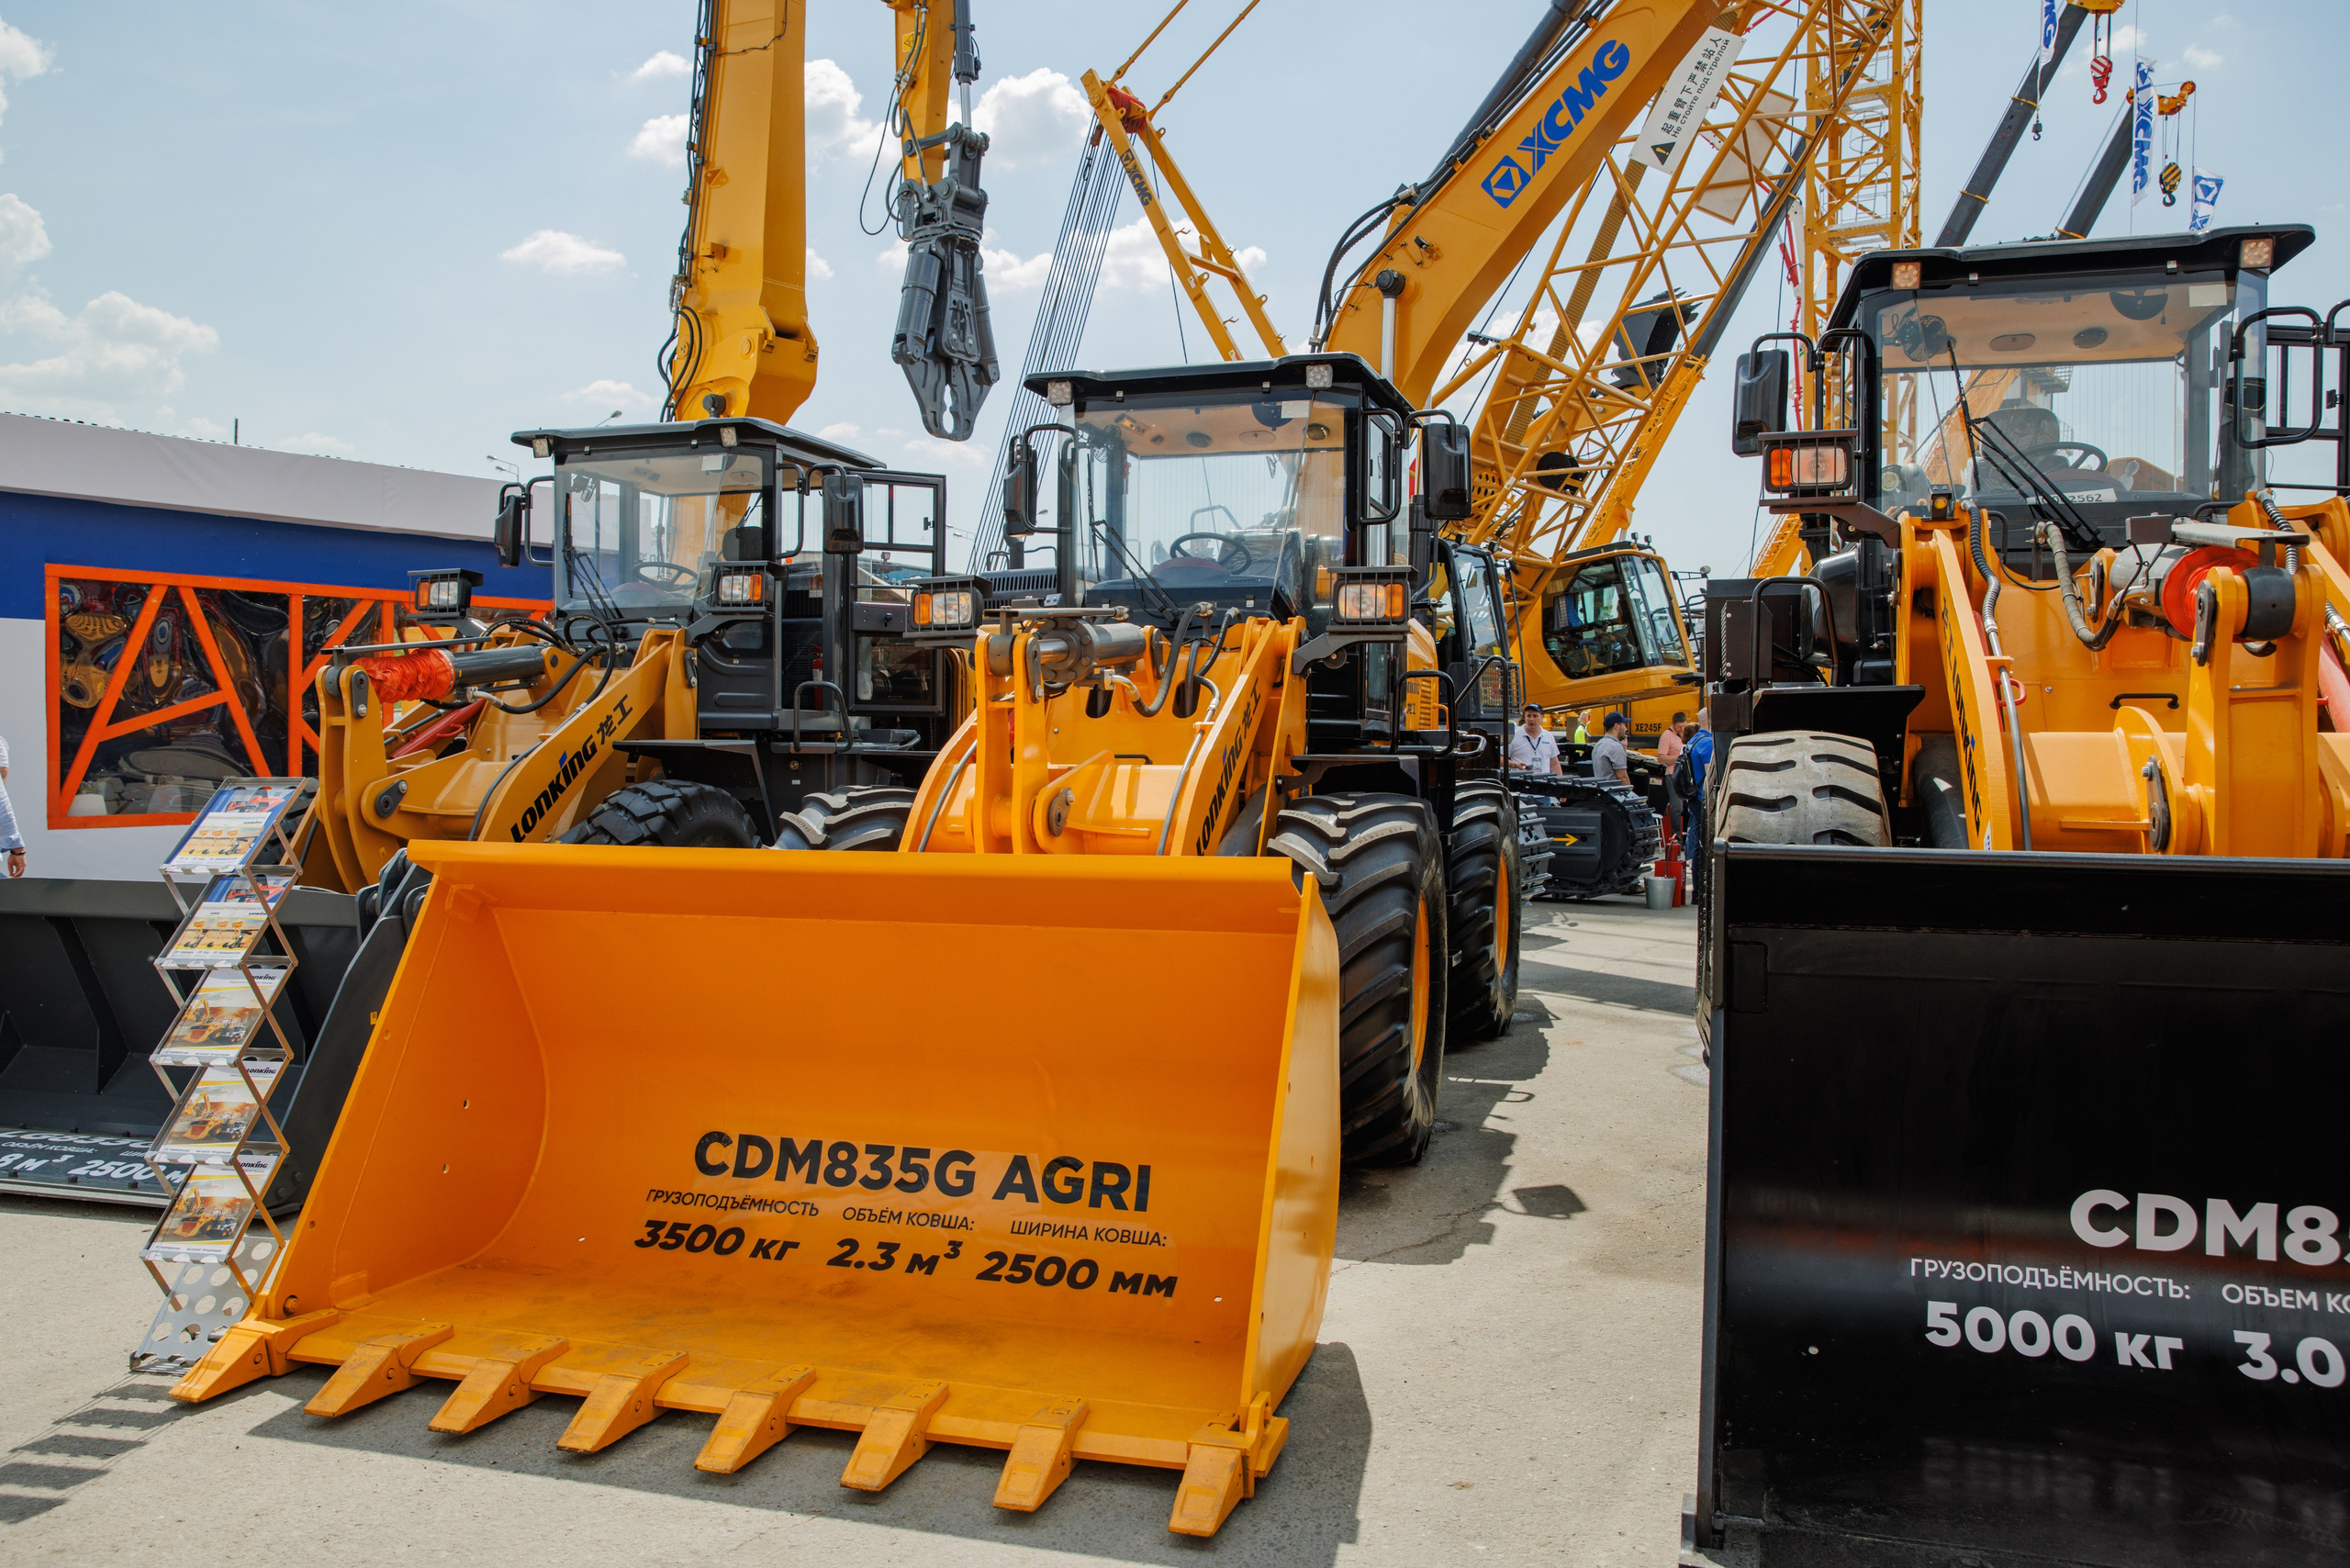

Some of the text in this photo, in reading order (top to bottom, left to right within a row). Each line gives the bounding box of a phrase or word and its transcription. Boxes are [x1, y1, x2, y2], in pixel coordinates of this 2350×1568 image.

[1516, 39, 1630, 176] XCMG
[1661, 38, 1722, 134] 起重臂下严禁站人
[1672, 39, 1729, 138] Не стойте под стрелой
[2132, 99, 2156, 194] XCMG
[1125, 163, 1152, 206] XCMG
[1635, 723, 1662, 732] XE245F
[67, 1159, 167, 1181] 2500
[694, 1130, 1151, 1213] CDM835G AGRI
[645, 1188, 820, 1217] ГРУЗОПОДЪЁМНОСТЬ
[905, 1209, 975, 1232] КОВША:
[634, 1219, 800, 1263] 3500 кг
[1010, 1219, 1168, 1247] ШИРИНА КОВША:
[2069, 1189, 2350, 1267] CDM8
[826, 1238, 900, 1271] 2.3
[976, 1249, 1179, 1298] 2500 мм
[1910, 1258, 2191, 1301] ГРУЗОПОДЪЁМНОСТЬ:
[2221, 1283, 2319, 1314] ОБЪЕМ
[1925, 1301, 2185, 1371] 5000 кг
[2233, 1330, 2346, 1388] 3.0
